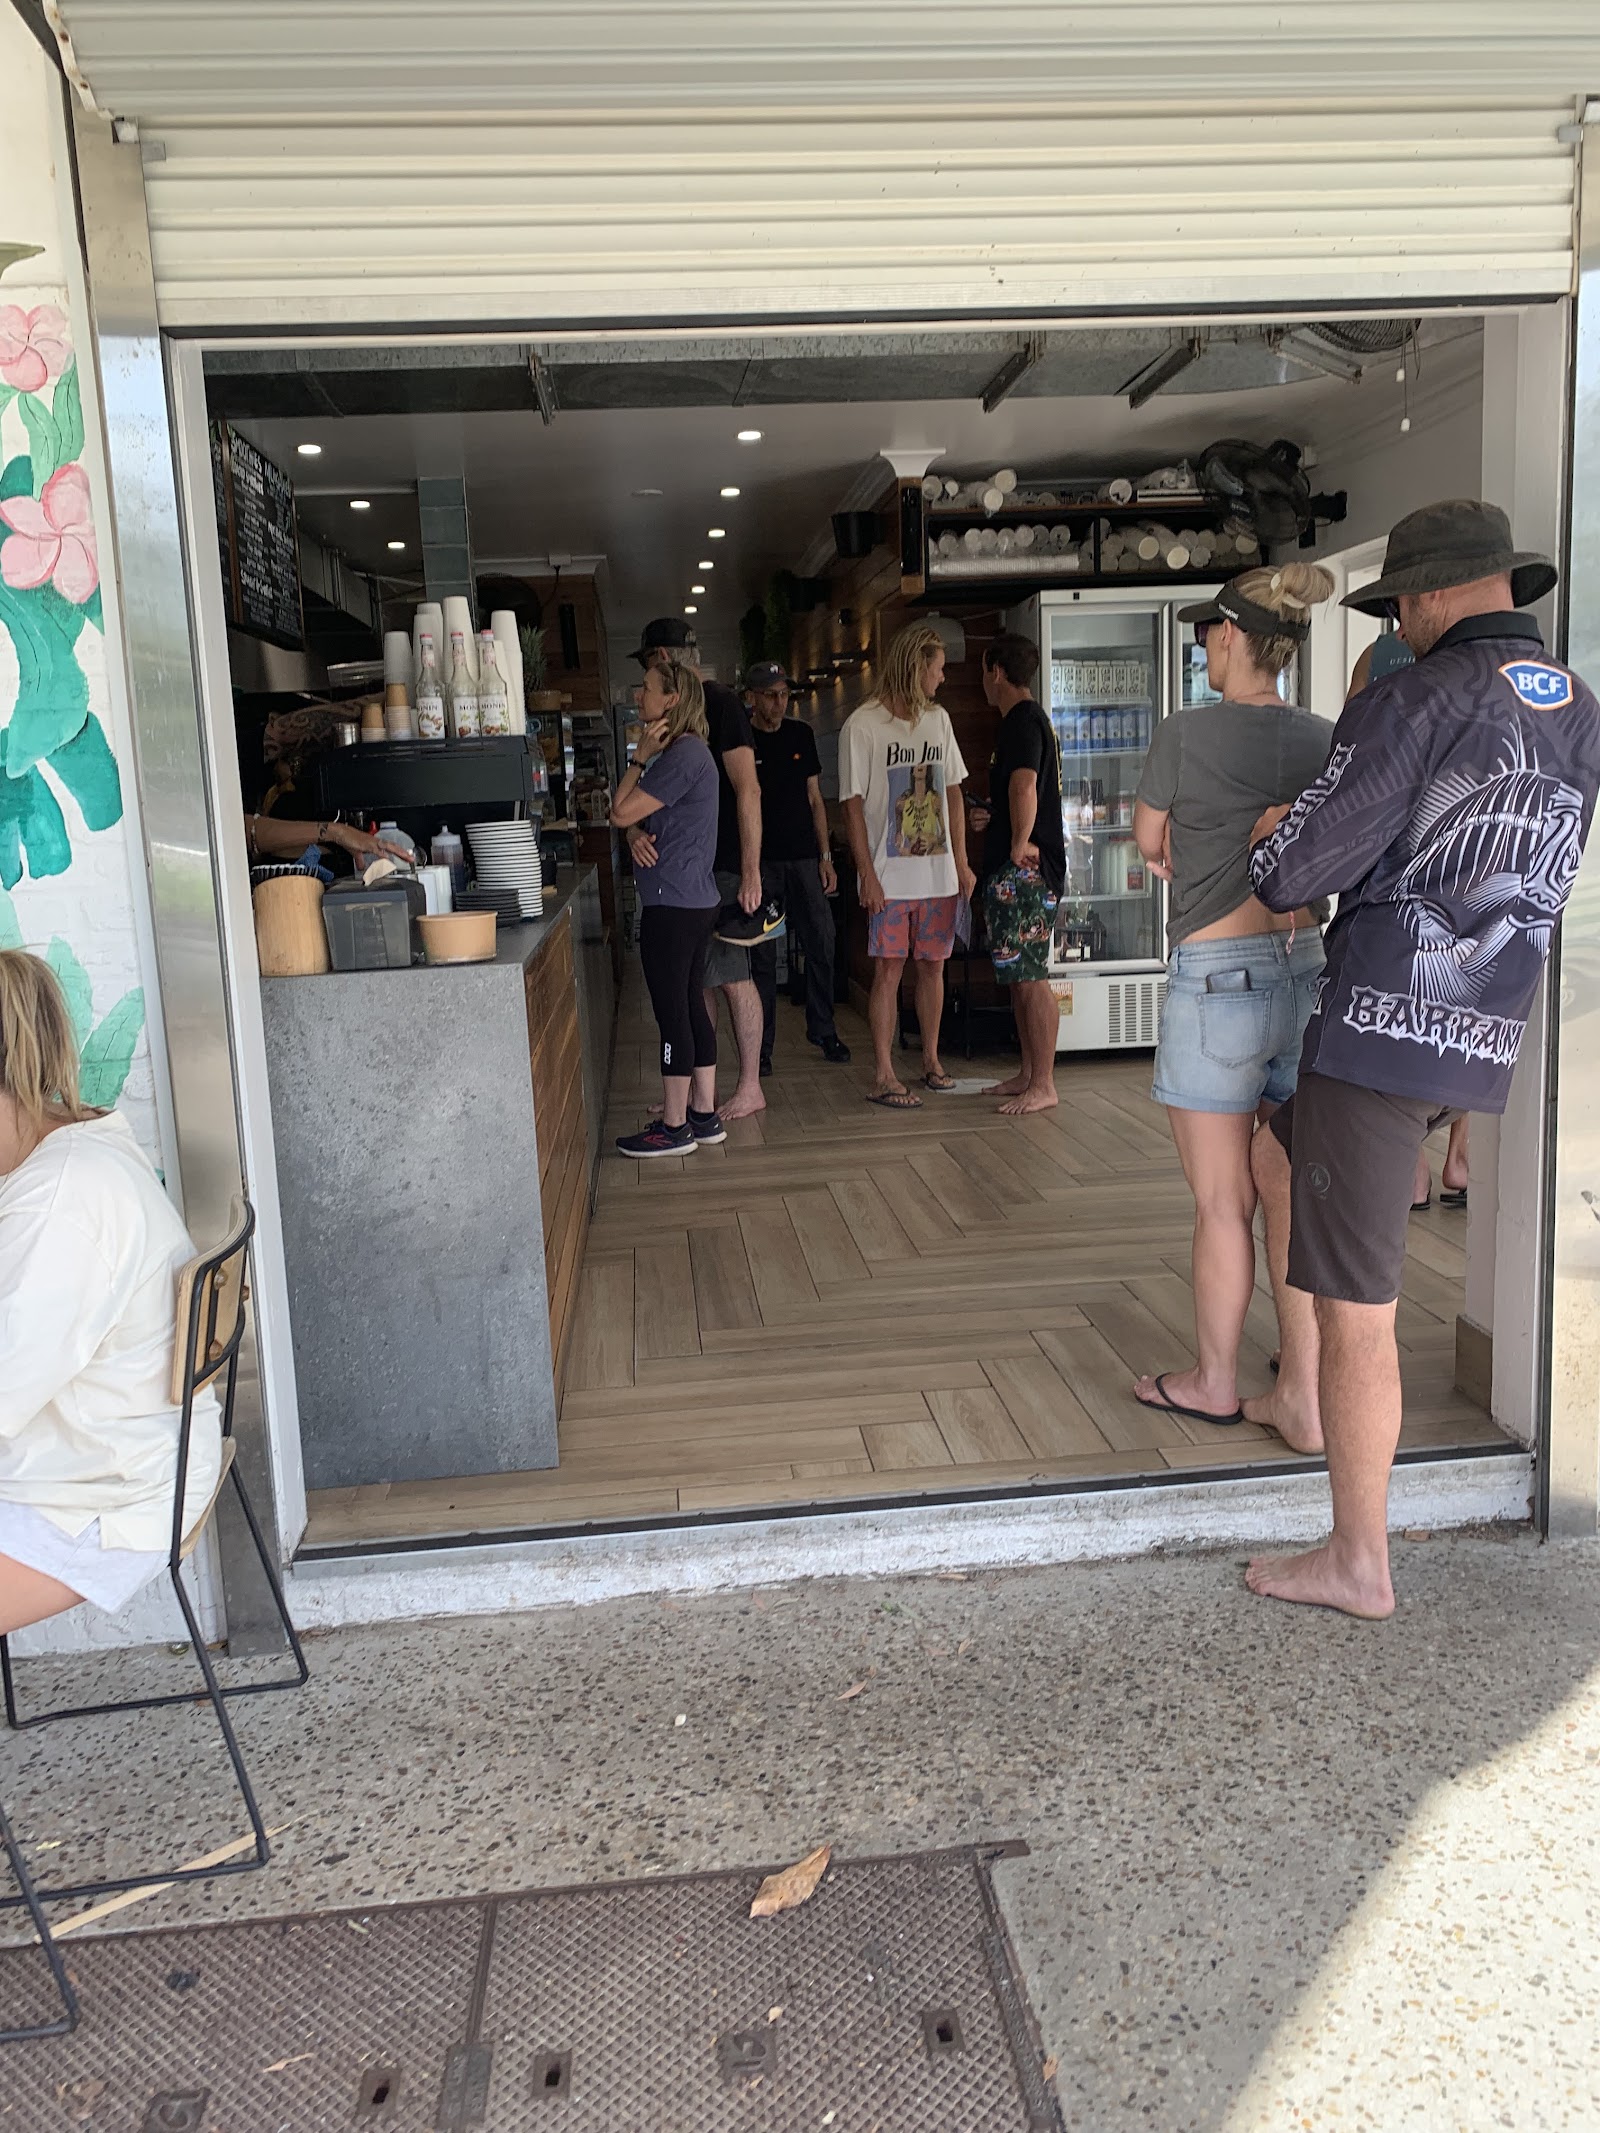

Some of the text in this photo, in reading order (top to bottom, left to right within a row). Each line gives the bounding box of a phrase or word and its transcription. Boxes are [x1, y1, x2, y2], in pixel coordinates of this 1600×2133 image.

[1516, 672, 1562, 696] BCF
[886, 740, 943, 767] Bon Jovi
